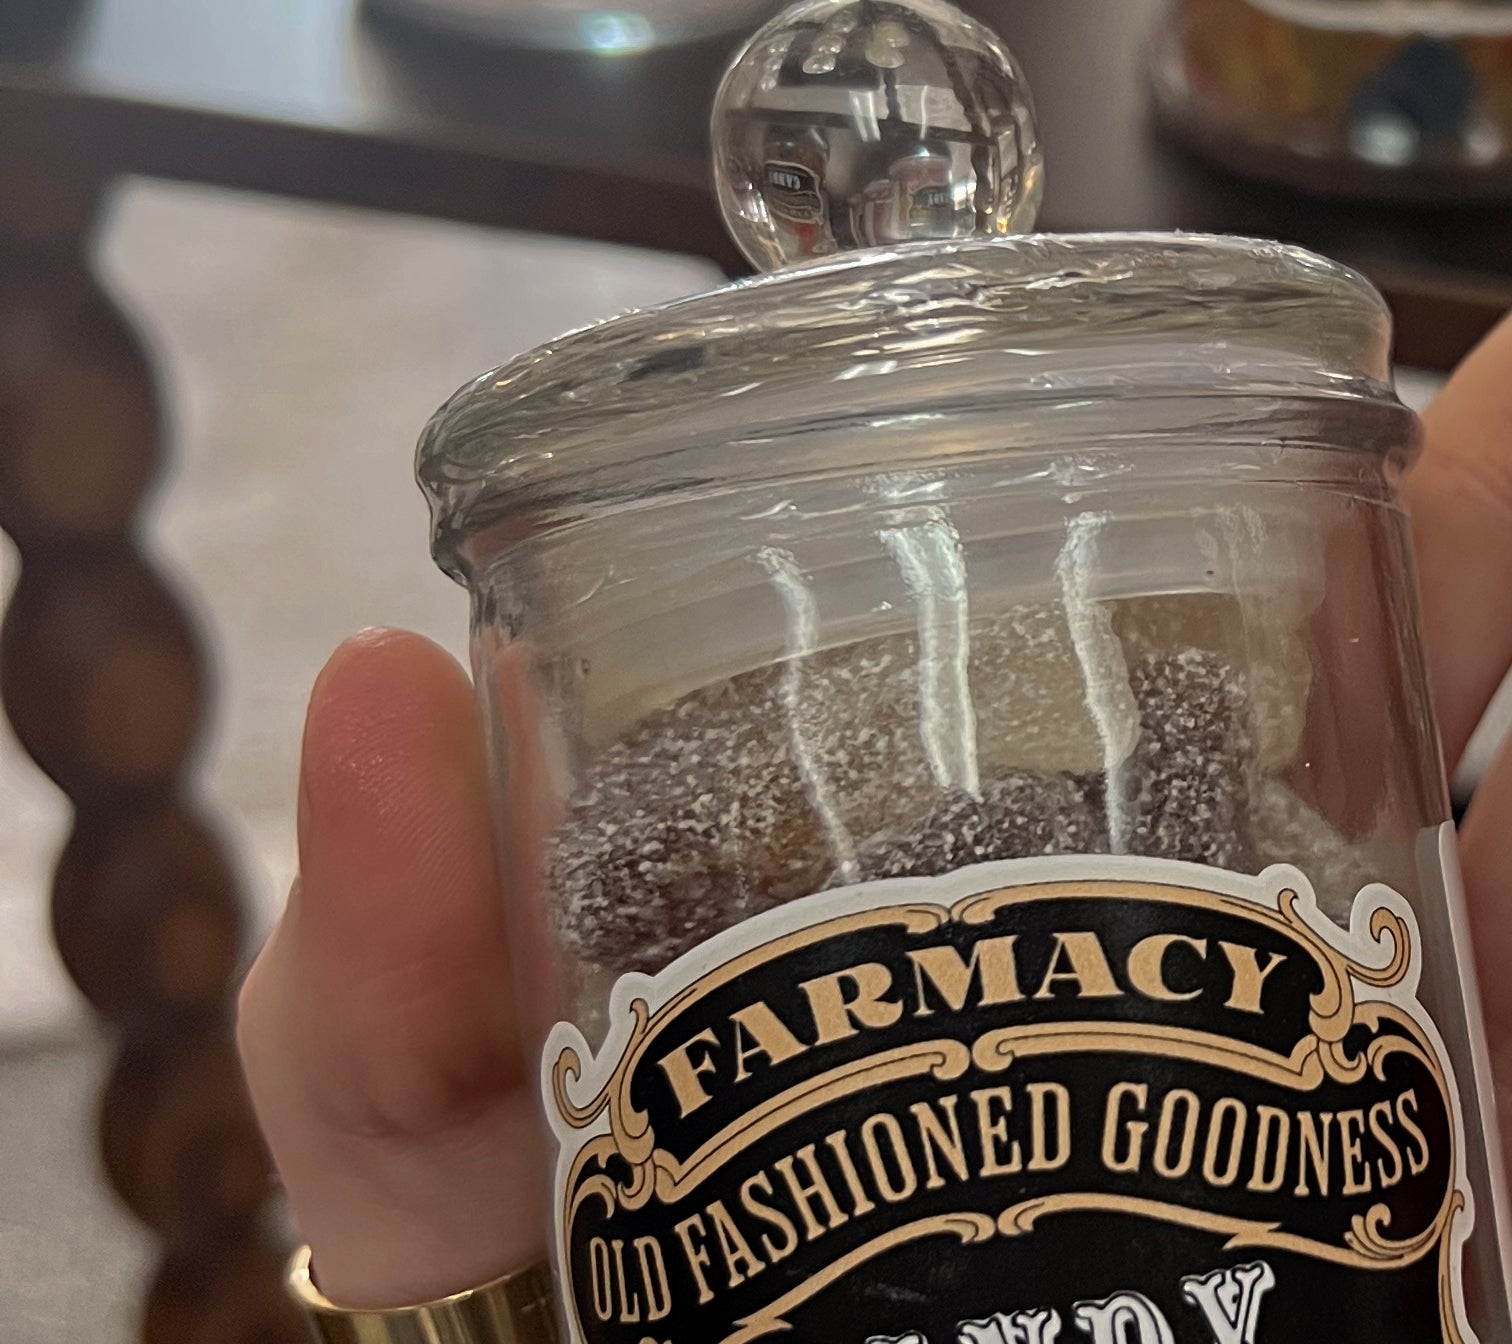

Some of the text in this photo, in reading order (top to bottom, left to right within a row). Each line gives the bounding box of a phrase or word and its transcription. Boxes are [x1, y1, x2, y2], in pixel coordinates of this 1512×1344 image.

[656, 932, 1288, 1119] FARMACY
[589, 1082, 1429, 1323] OLD FASHIONED GOODNESS
